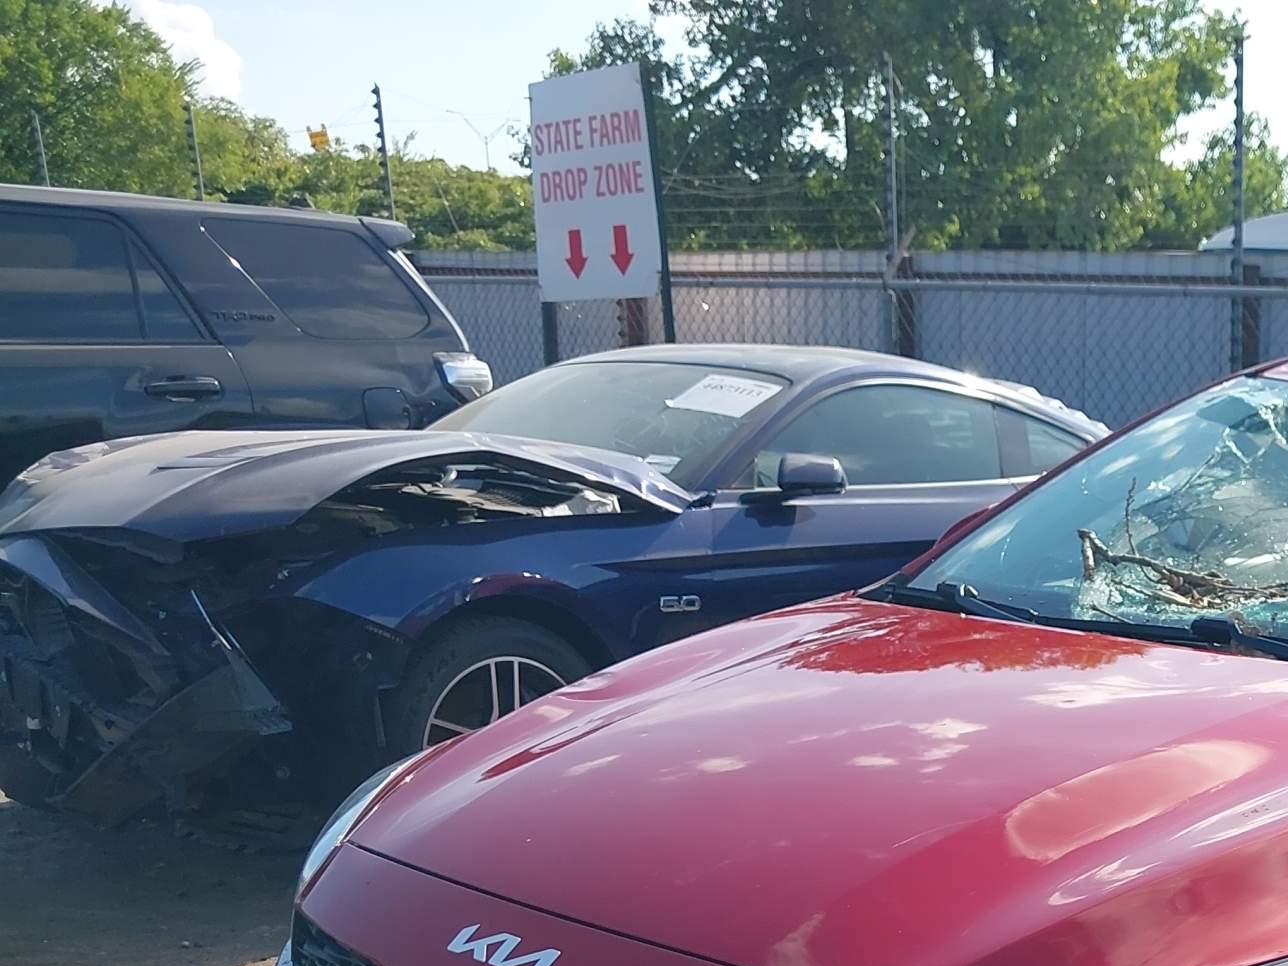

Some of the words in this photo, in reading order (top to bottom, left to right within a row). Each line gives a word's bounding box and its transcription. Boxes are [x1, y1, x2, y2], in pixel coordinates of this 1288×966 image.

[534, 118, 584, 156] STATE
[588, 109, 642, 148] FARM
[540, 167, 588, 203] DROP
[593, 161, 644, 197] ZONE
